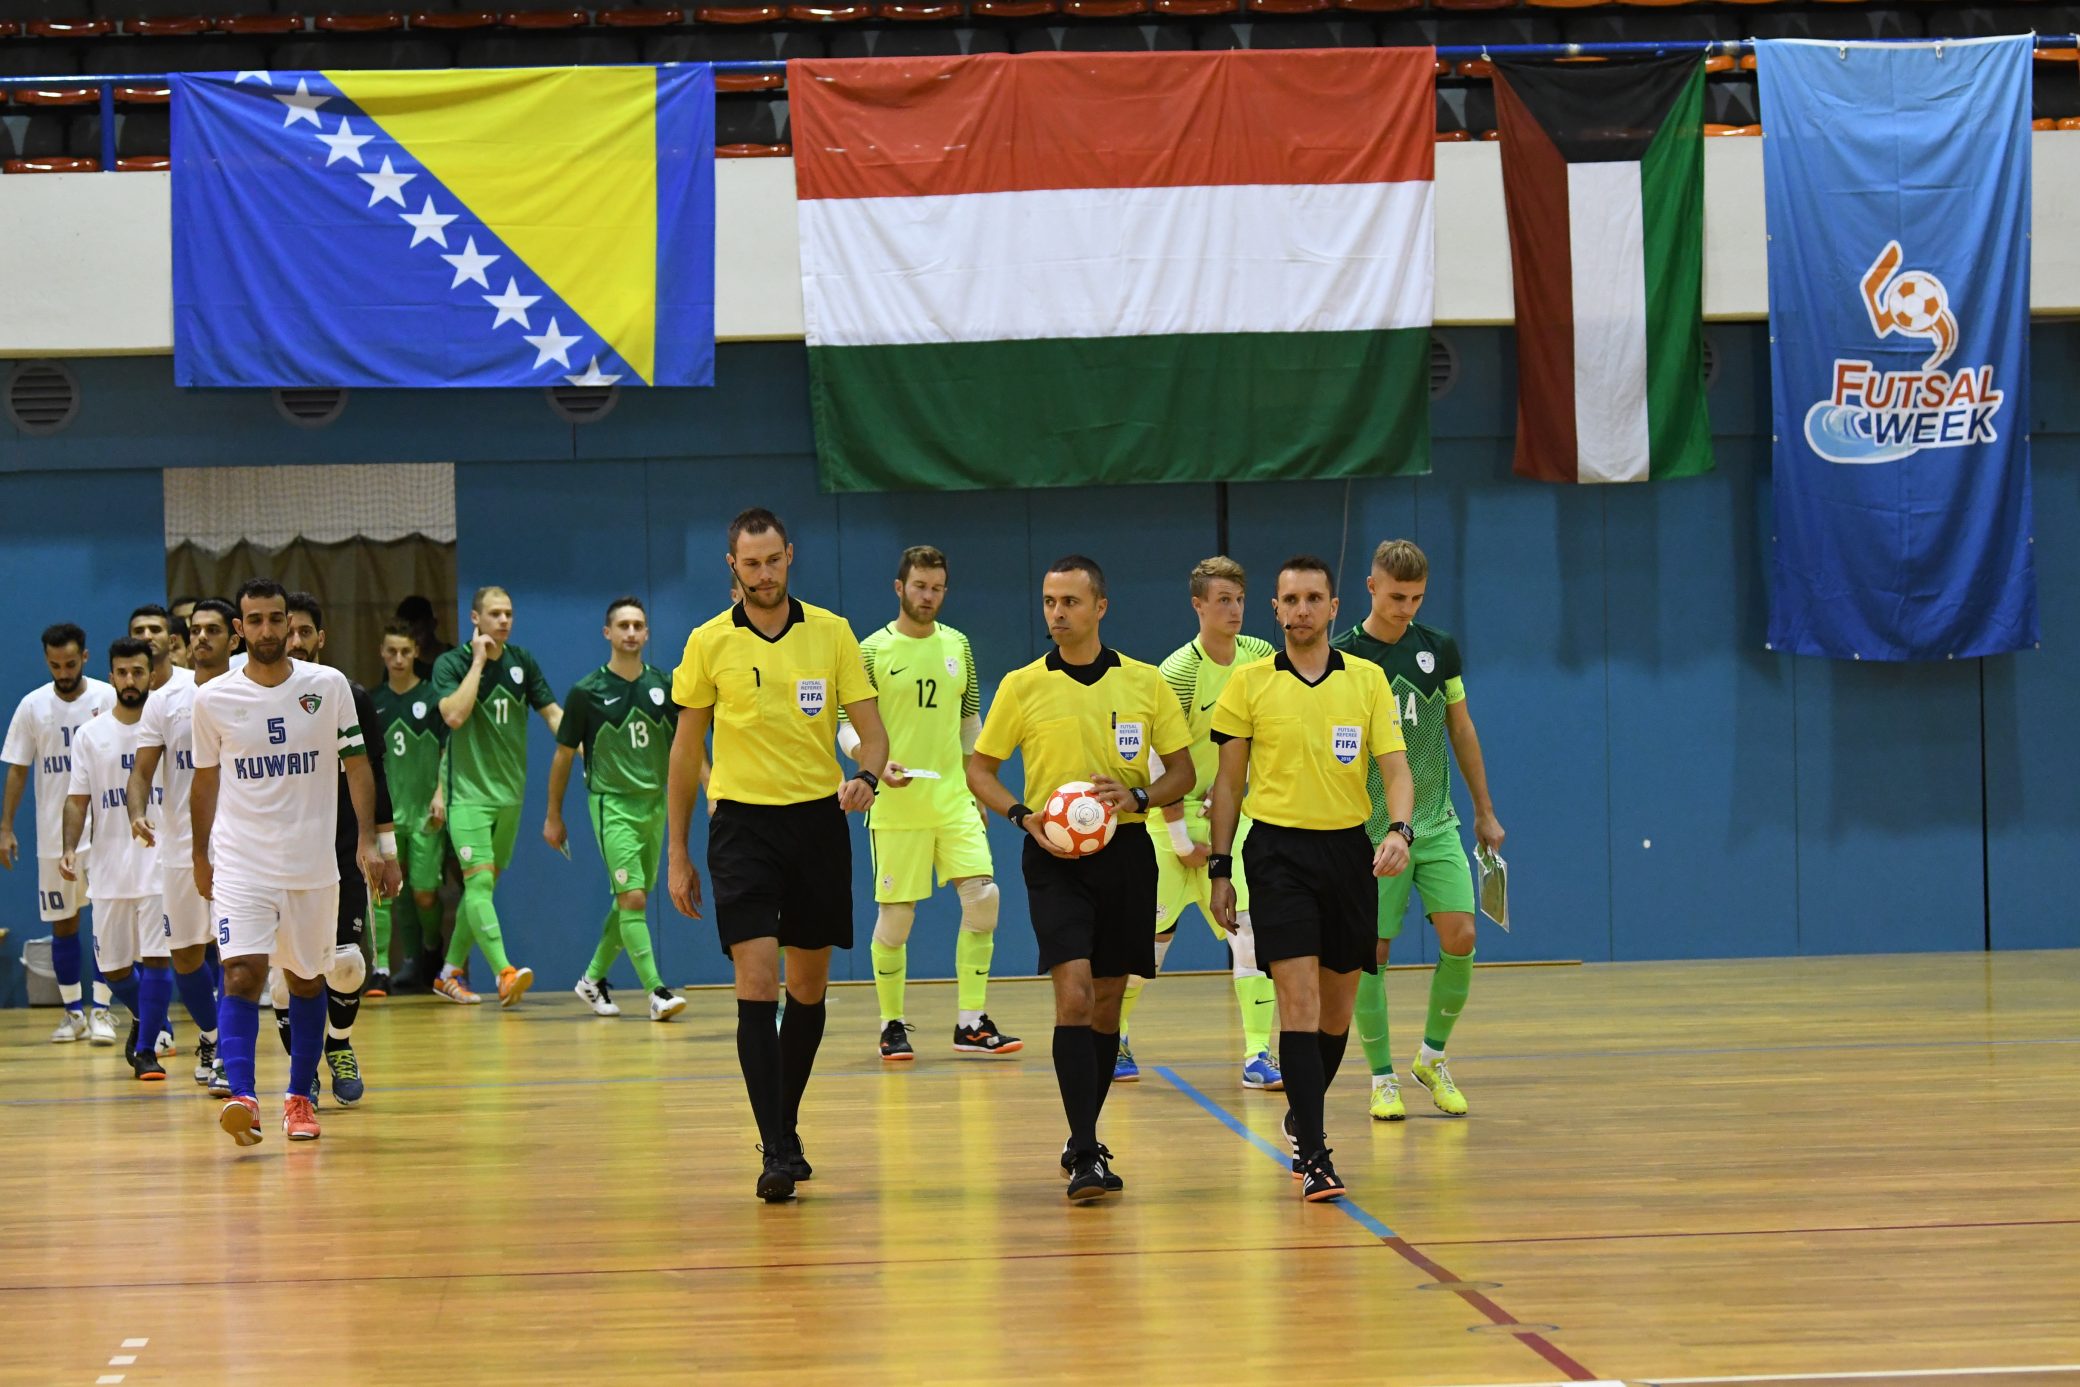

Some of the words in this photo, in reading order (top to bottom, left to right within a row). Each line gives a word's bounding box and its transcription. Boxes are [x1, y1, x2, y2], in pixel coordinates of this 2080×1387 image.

[1835, 363, 1999, 409] FUTSAL
[1875, 407, 1992, 444] WEEK
[800, 693, 823, 701] FIFA
[916, 679, 938, 708] 12
[494, 698, 508, 724] 11
[267, 717, 287, 744] 5
[628, 721, 649, 748] 13
[1119, 736, 1140, 746] FIFA
[393, 732, 406, 757] 3
[1335, 740, 1358, 749] FIFA
[234, 751, 319, 779] KUWAIT
[40, 891, 64, 910] 10
[219, 918, 230, 946] 5
